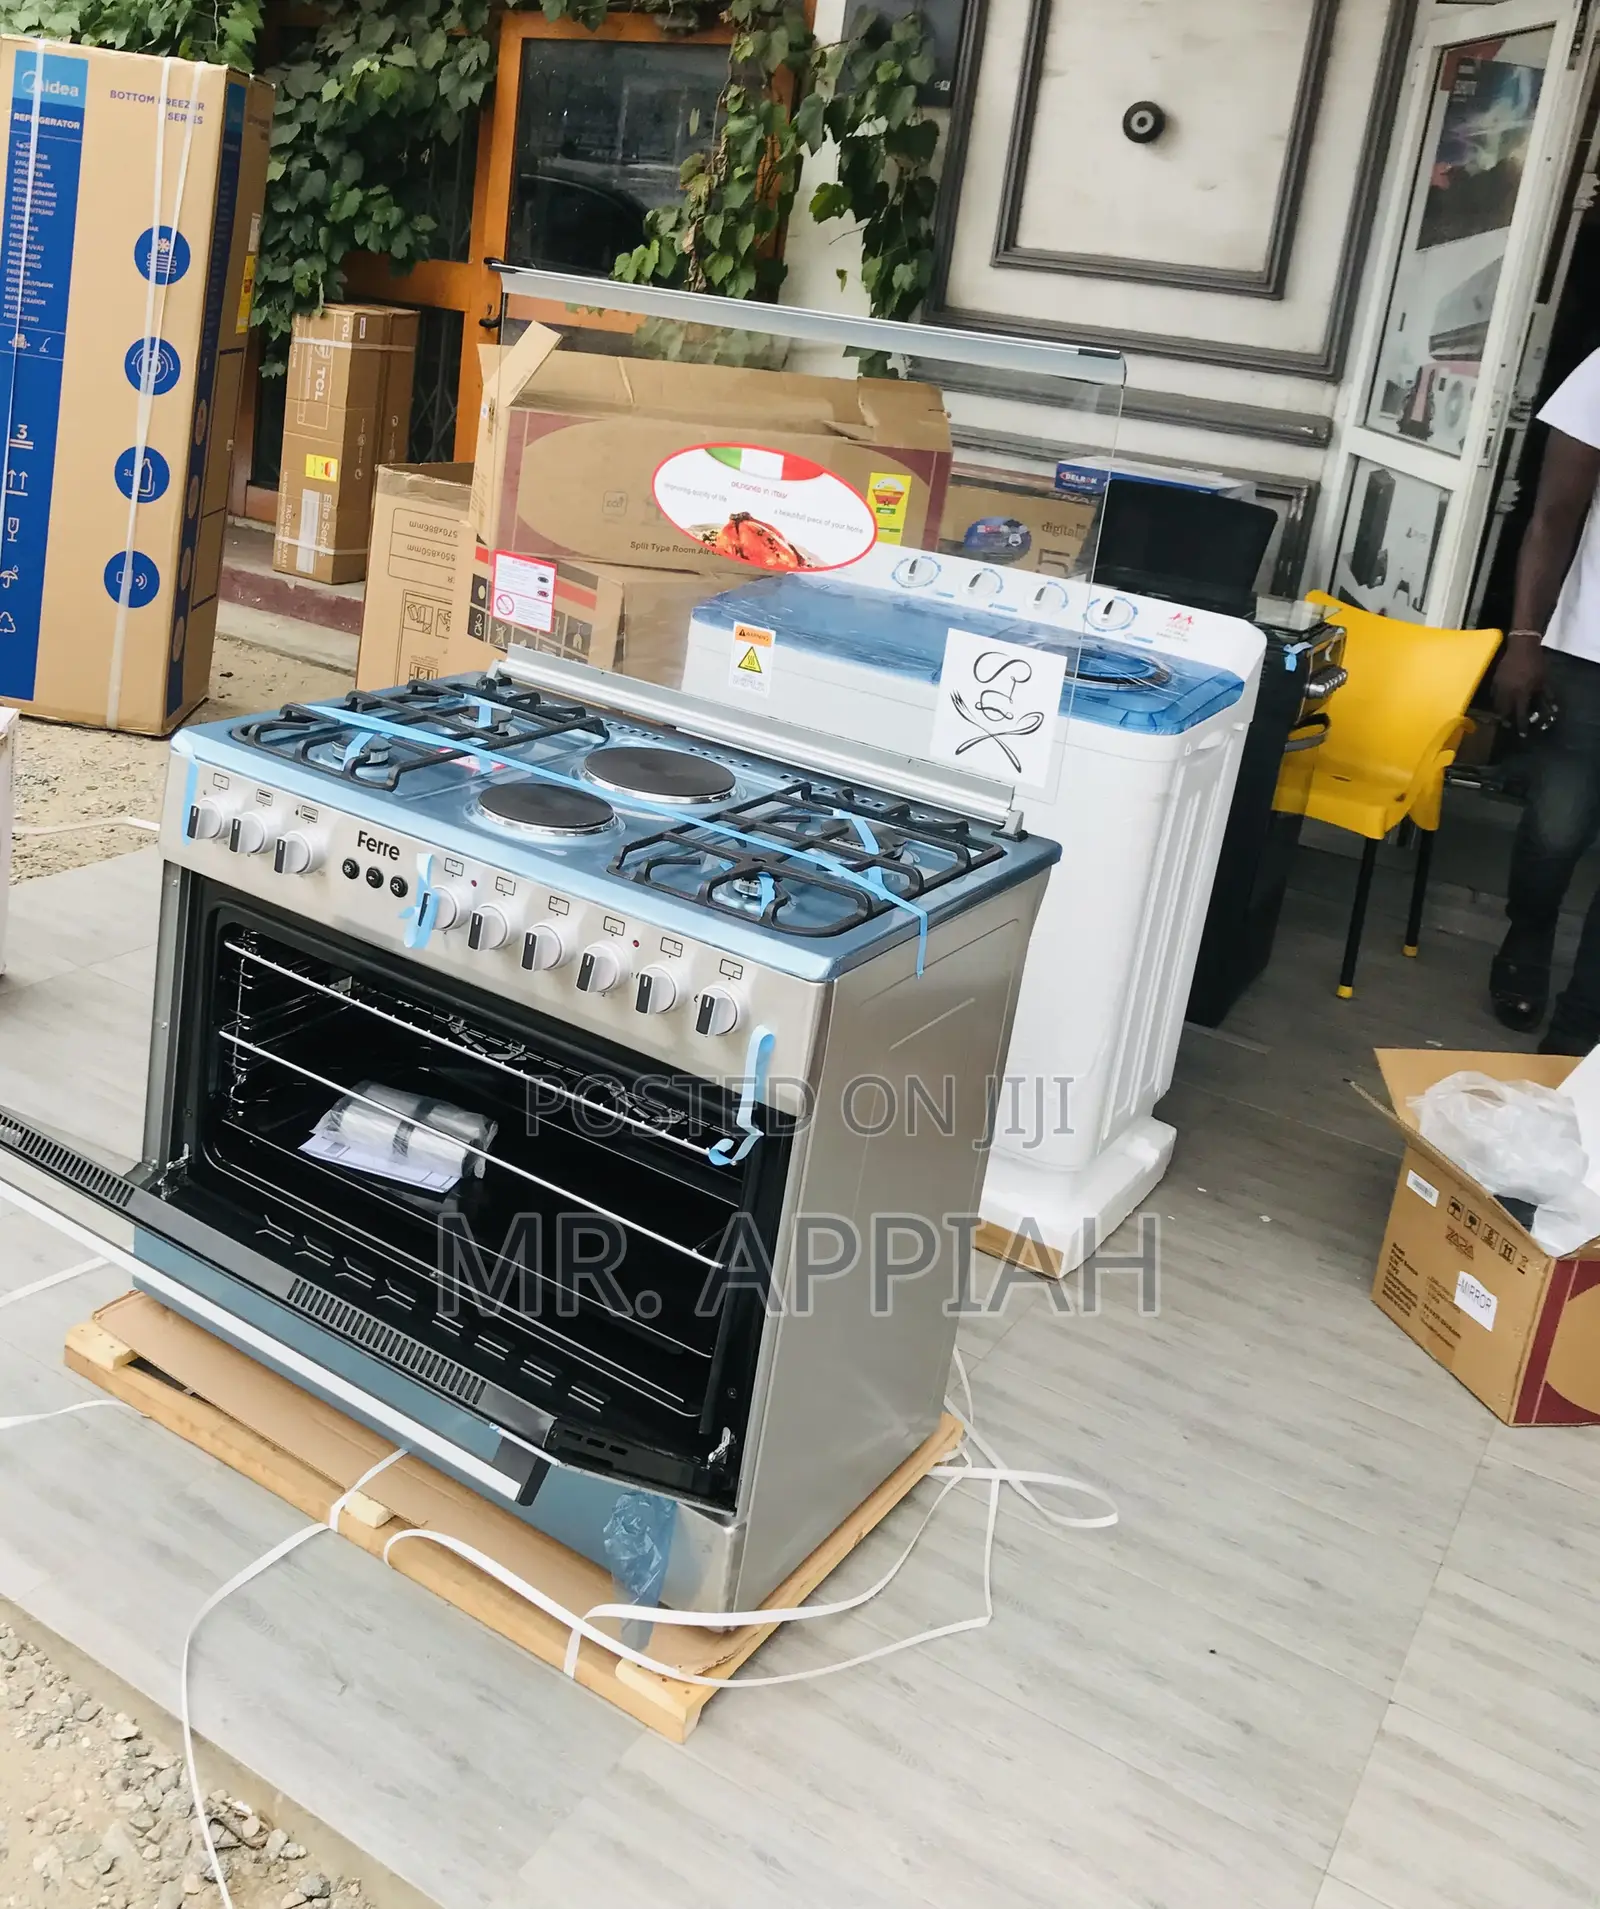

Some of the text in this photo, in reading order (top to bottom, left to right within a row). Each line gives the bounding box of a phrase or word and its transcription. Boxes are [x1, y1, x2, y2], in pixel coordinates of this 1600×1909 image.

[22, 70, 80, 97] idea
[110, 89, 205, 112] BOTTOM REEZR
[13, 112, 81, 131] REFGERATOR
[167, 111, 204, 125] SERES
[341, 316, 351, 341] TCL
[314, 366, 327, 401] TCL
[17, 424, 28, 439] 3
[319, 493, 333, 557] Elite Seris
[831, 521, 846, 529] your
[846, 524, 864, 534] home
[630, 541, 650, 552] Split
[651, 543, 670, 554] Type
[672, 545, 697, 555] Room
[698, 547, 711, 556] Air
[356, 830, 401, 861] Ferre
